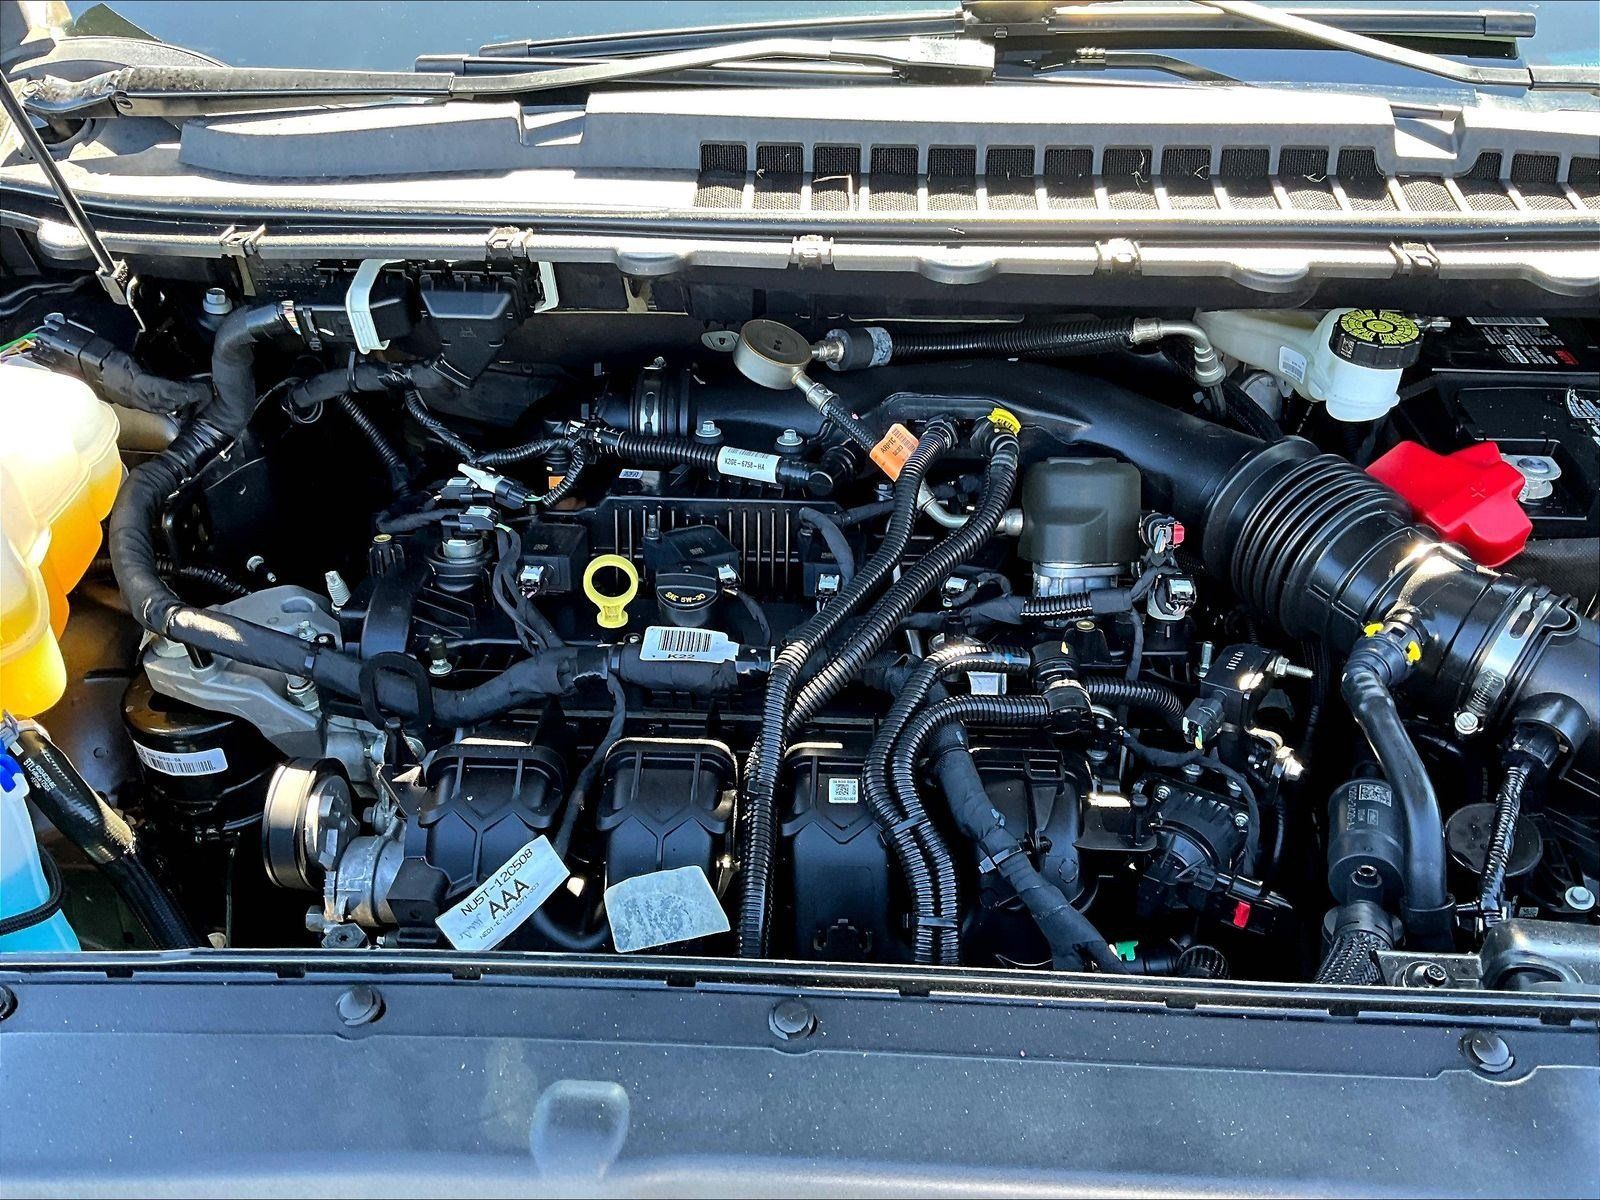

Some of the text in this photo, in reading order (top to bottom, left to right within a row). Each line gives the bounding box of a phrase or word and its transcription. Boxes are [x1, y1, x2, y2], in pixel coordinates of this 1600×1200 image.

[664, 591, 680, 602] SAE
[461, 848, 533, 915] NU5T-12C508
[488, 878, 528, 919] AAA
